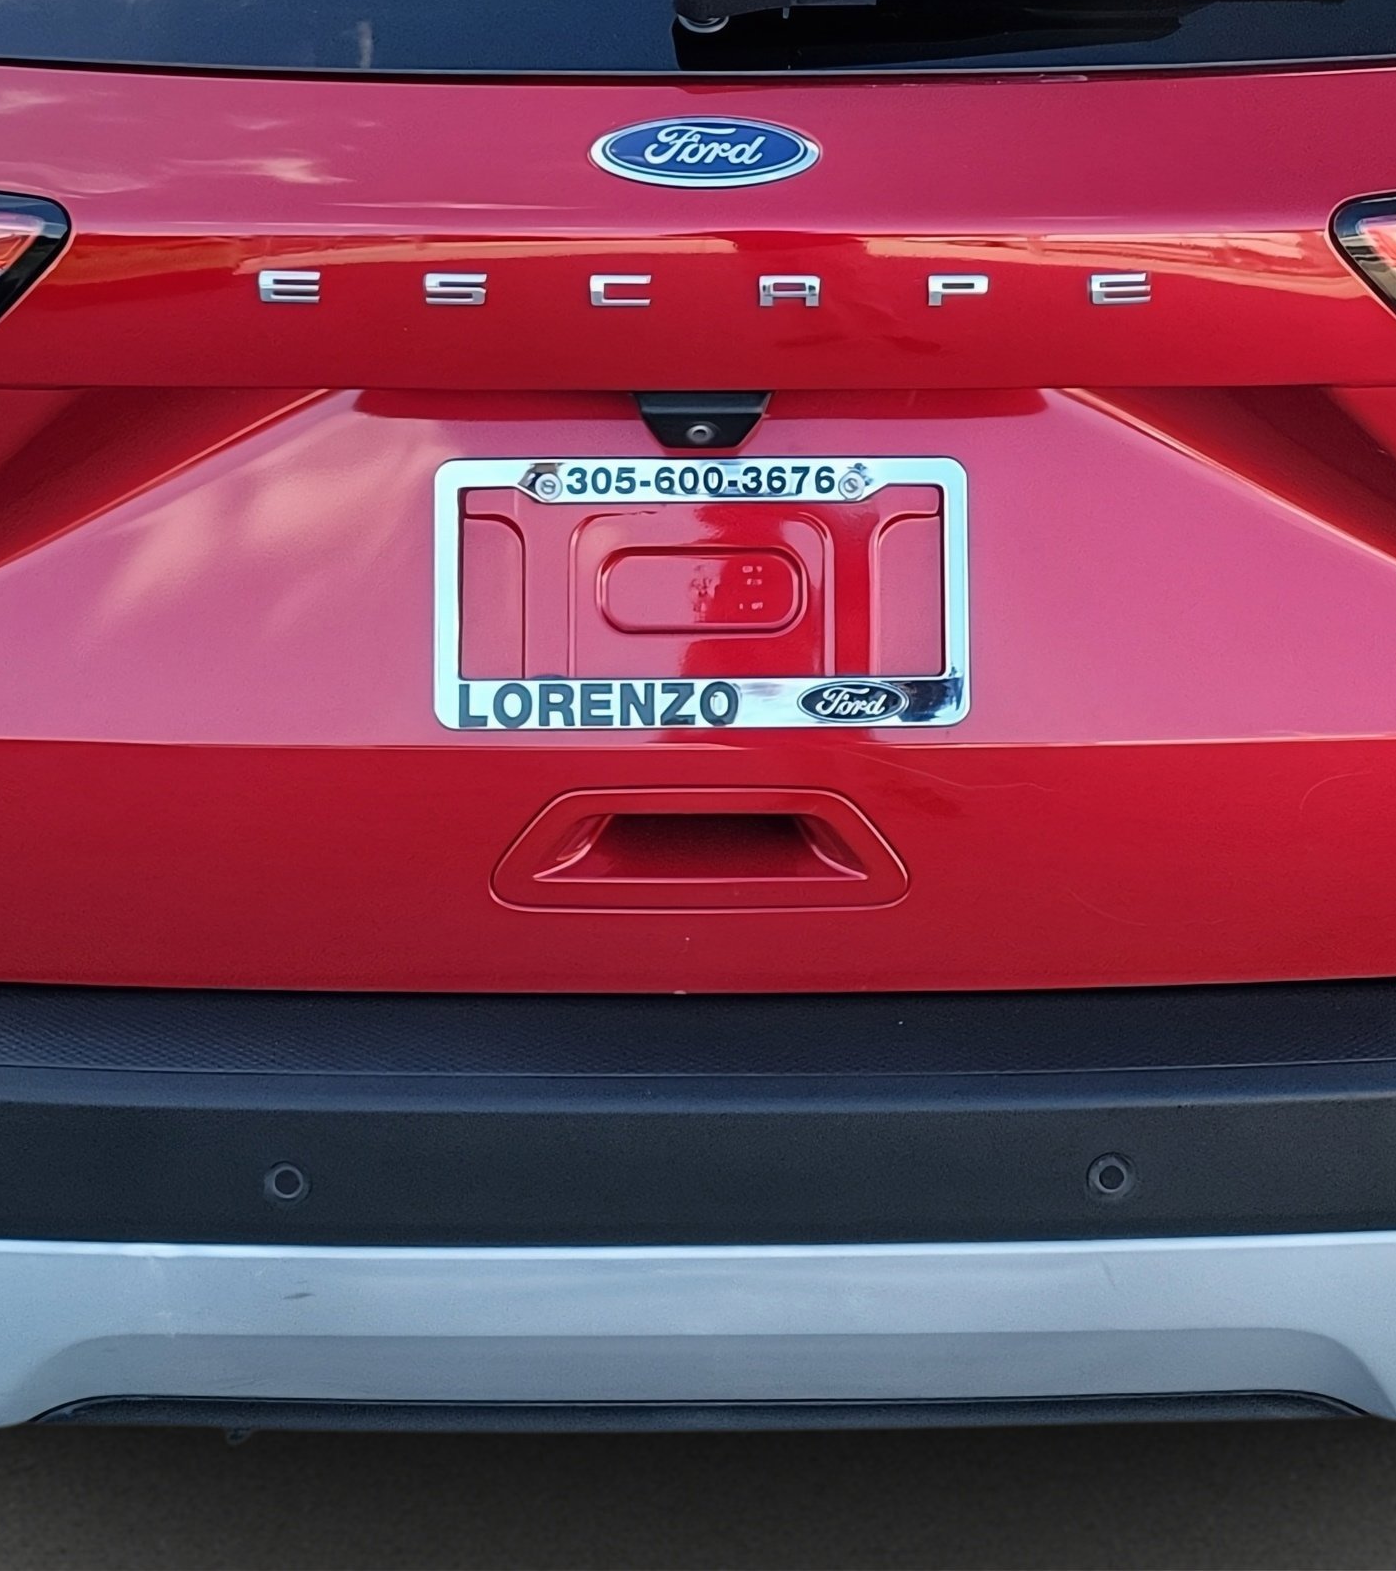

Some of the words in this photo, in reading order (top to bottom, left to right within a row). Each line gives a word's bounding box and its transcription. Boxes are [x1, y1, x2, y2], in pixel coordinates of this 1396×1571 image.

[644, 125, 765, 167] Ford
[258, 271, 1152, 308] ESCAPE
[566, 466, 836, 495] 305-600-3676
[458, 682, 739, 727] LORENZO
[815, 687, 886, 717] Ford
